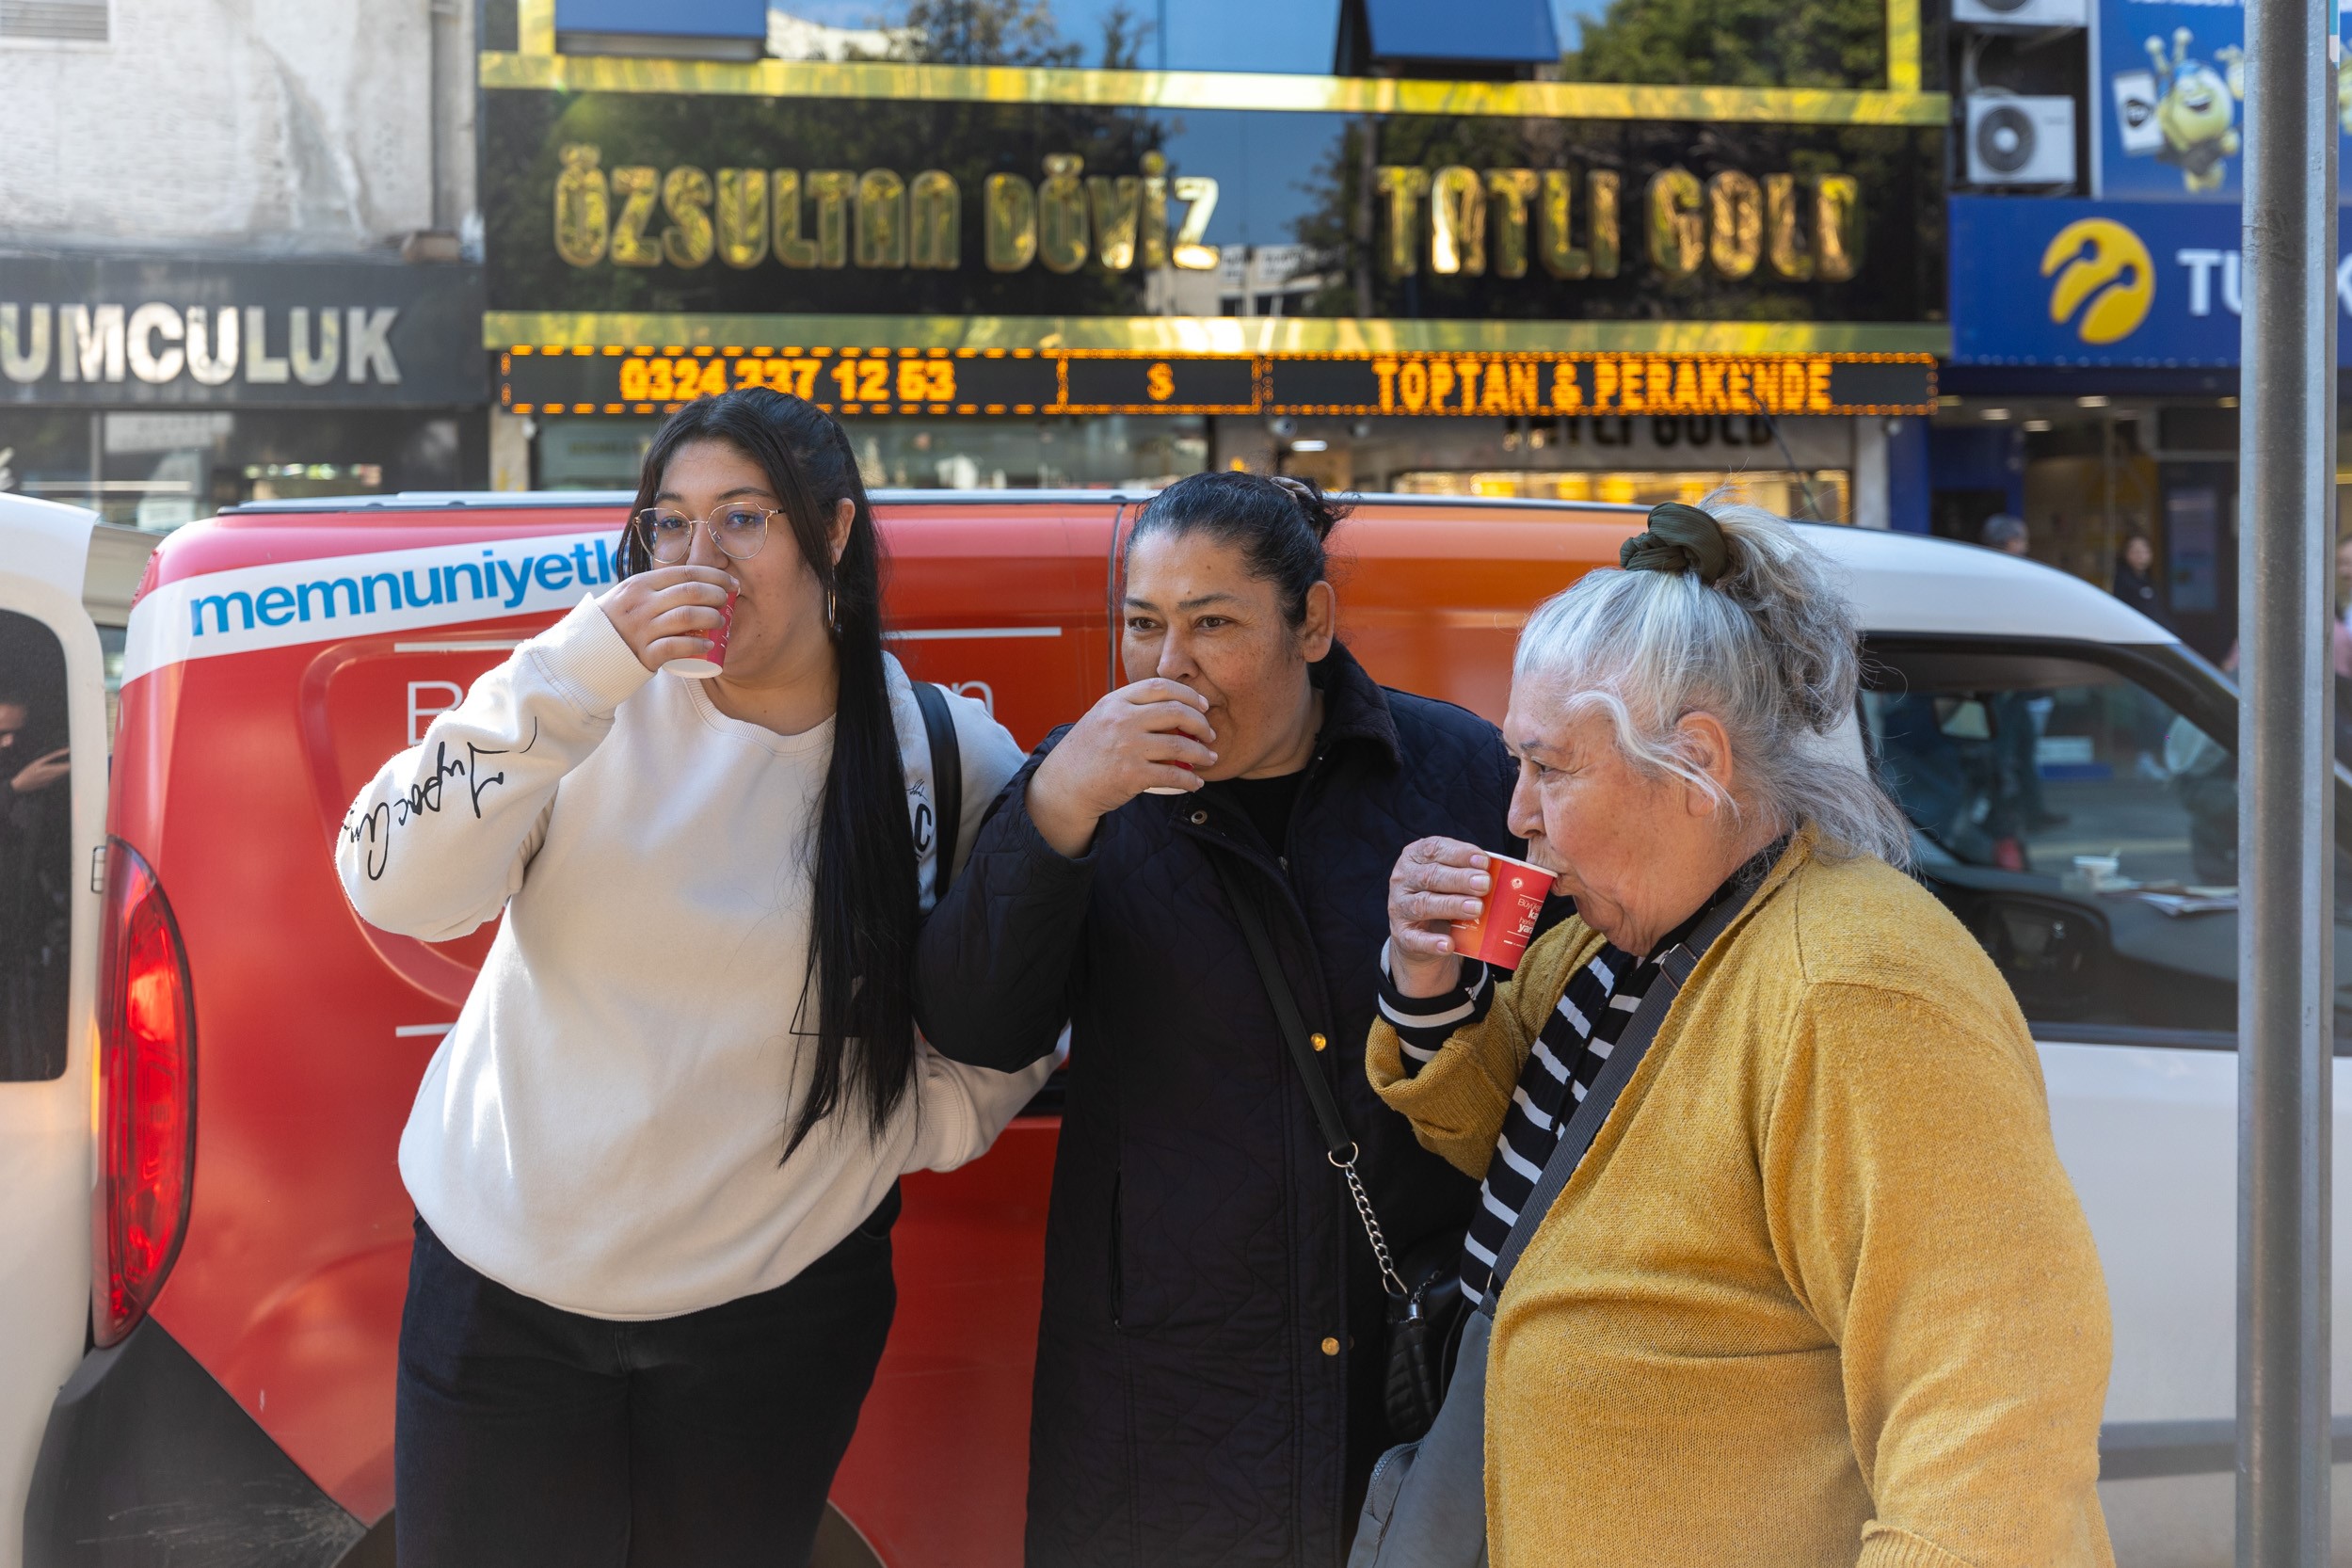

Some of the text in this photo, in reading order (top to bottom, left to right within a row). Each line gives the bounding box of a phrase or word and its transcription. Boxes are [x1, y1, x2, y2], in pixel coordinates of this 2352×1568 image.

[553, 142, 1221, 274] ÖZSULTAN DÖVİZ
[1374, 165, 1865, 282] TATLI GOLD
[0, 301, 402, 385] UMCULUK
[619, 358, 728, 401] 0324
[831, 359, 890, 402] 12
[1372, 360, 1833, 413] TOPTAN & PERAKENDE
